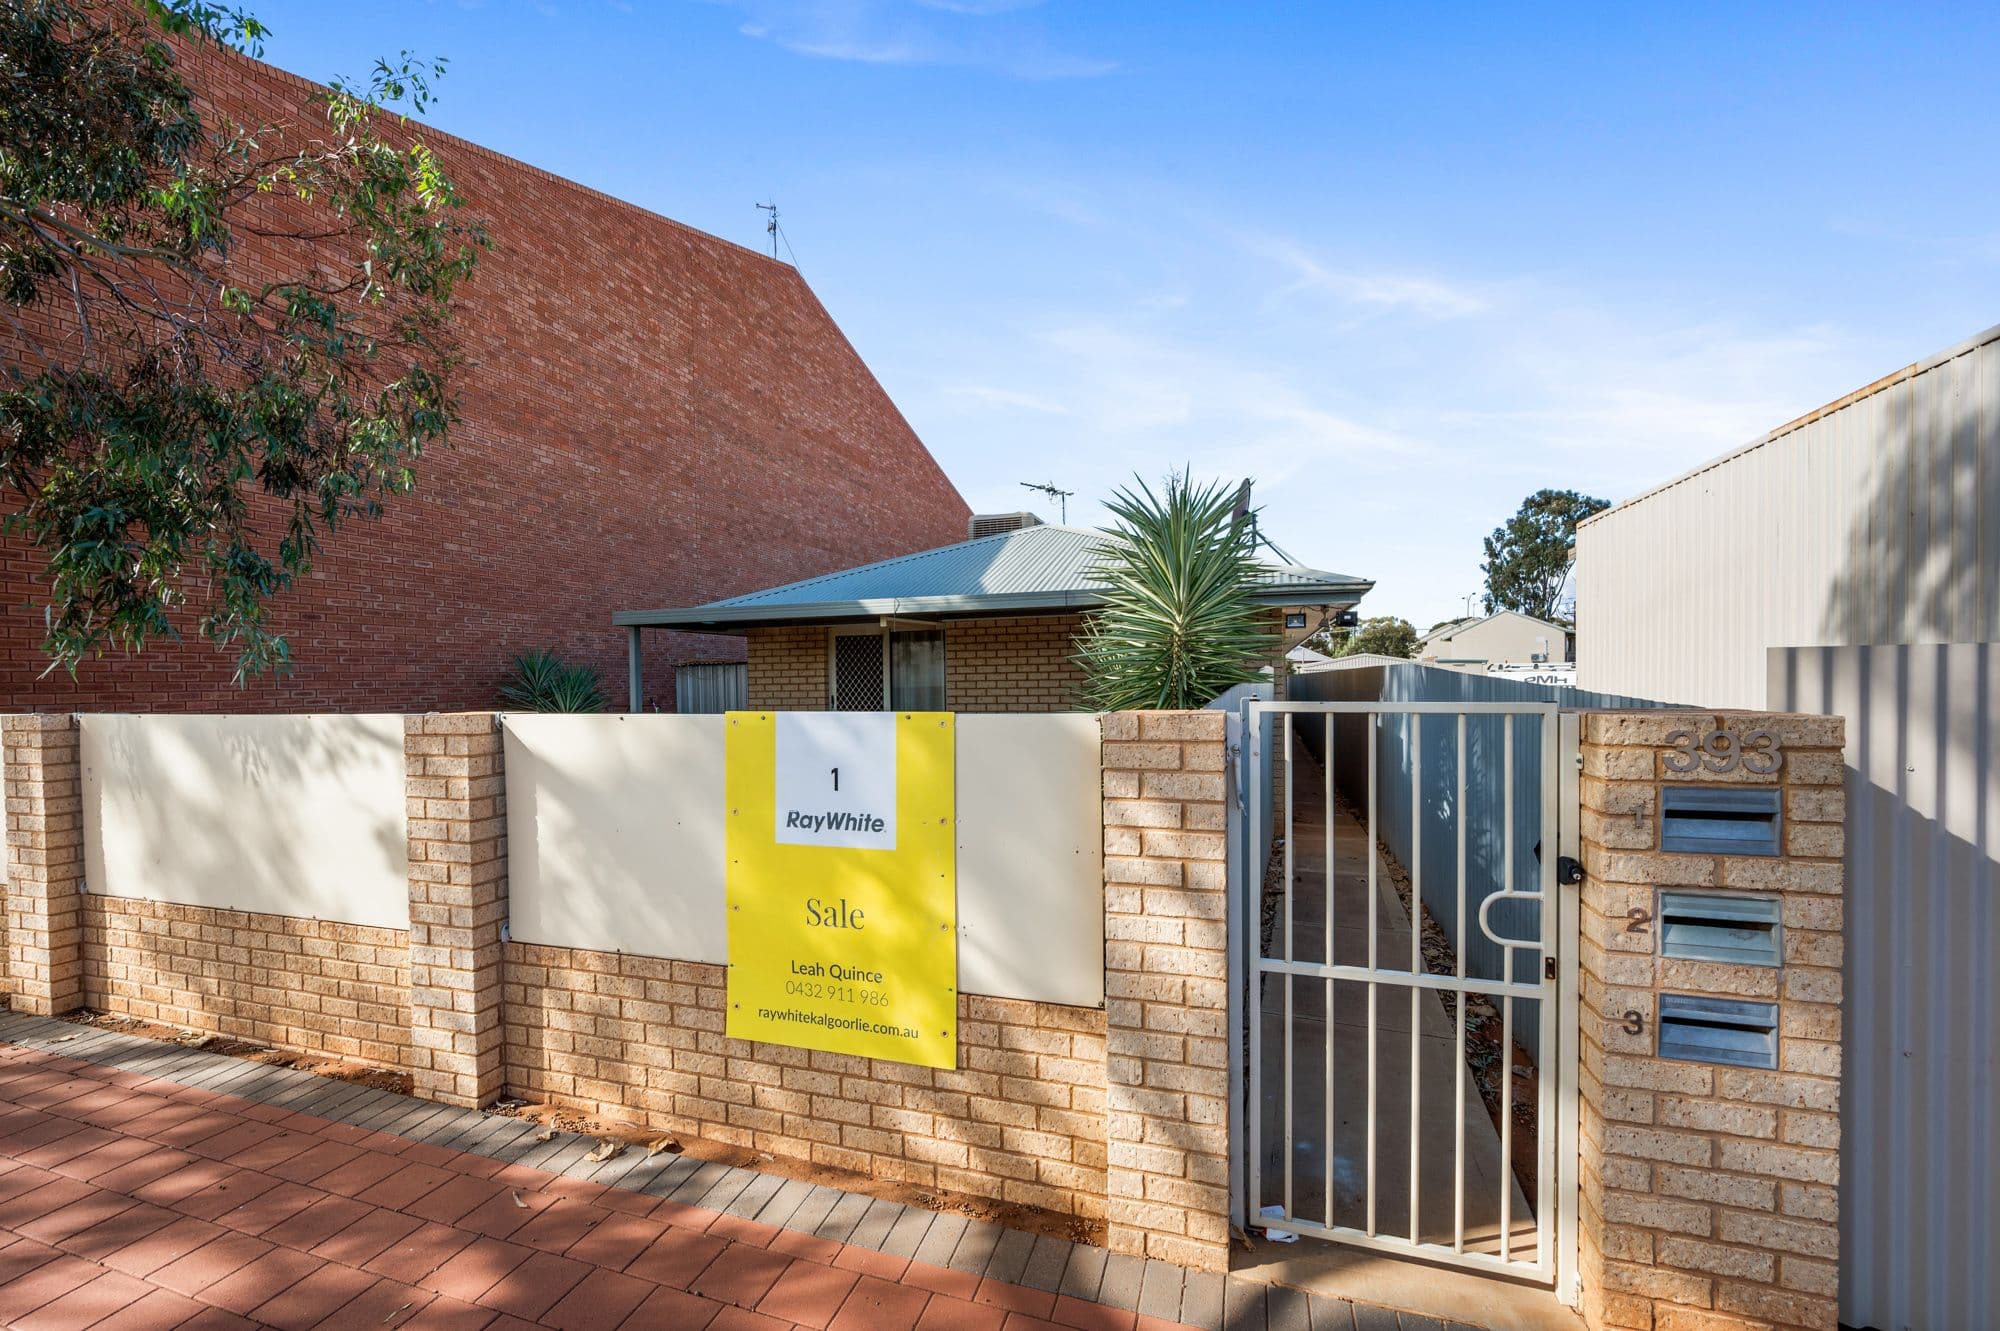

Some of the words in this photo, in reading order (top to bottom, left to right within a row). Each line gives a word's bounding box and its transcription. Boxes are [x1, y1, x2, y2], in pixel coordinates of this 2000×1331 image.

[1662, 729, 1783, 774] 393
[831, 767, 839, 791] 1
[786, 810, 885, 834] RayWhite
[1631, 805, 1643, 829] 1
[806, 897, 865, 930] Sale
[1626, 907, 1649, 933] 2
[791, 960, 825, 977] Leah
[829, 964, 883, 984] Quince
[785, 980, 823, 999] 0432
[827, 985, 854, 1003] 911
[860, 989, 889, 1007] 986
[758, 1008, 919, 1039] raywhitekalgoorlie.com.au
[1622, 1009, 1644, 1035] 3
